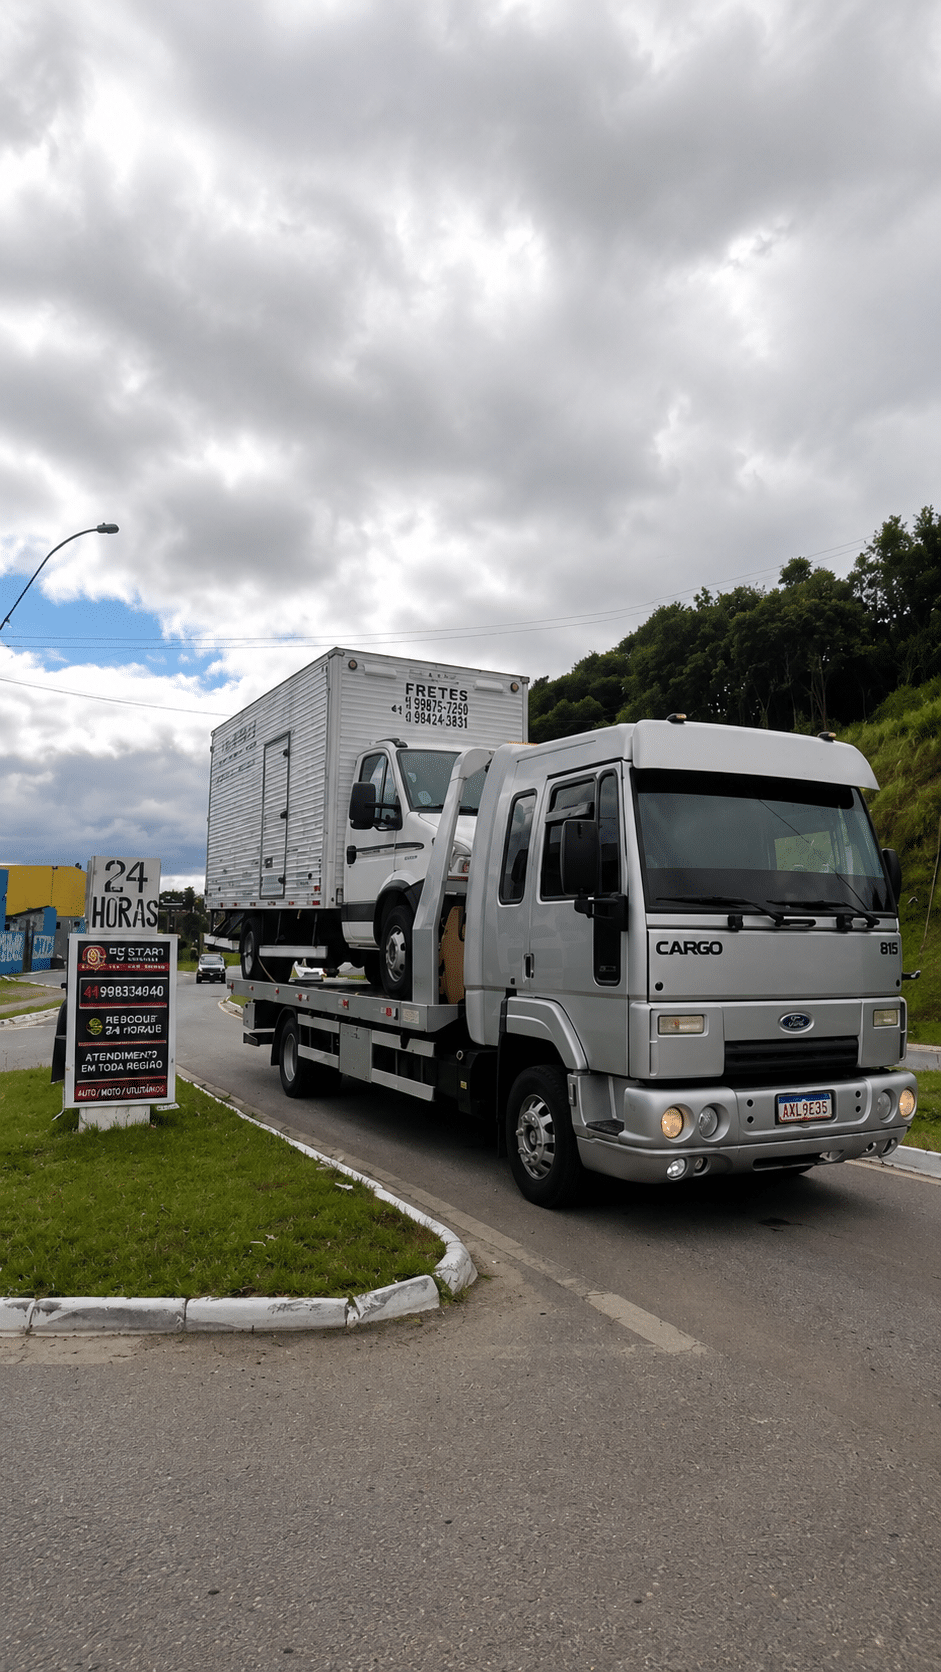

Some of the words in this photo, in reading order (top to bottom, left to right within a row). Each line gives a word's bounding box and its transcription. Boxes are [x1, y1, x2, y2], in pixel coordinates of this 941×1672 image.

[406, 682, 468, 701] FRETES
[104, 859, 148, 893] 24
[92, 896, 159, 928] HORAS
[655, 940, 723, 955] CARGO
[880, 941, 899, 955] 815
[81, 1064, 96, 1073] EM
[98, 1062, 124, 1072] TODA
[783, 1100, 828, 1118] AXL9E35
